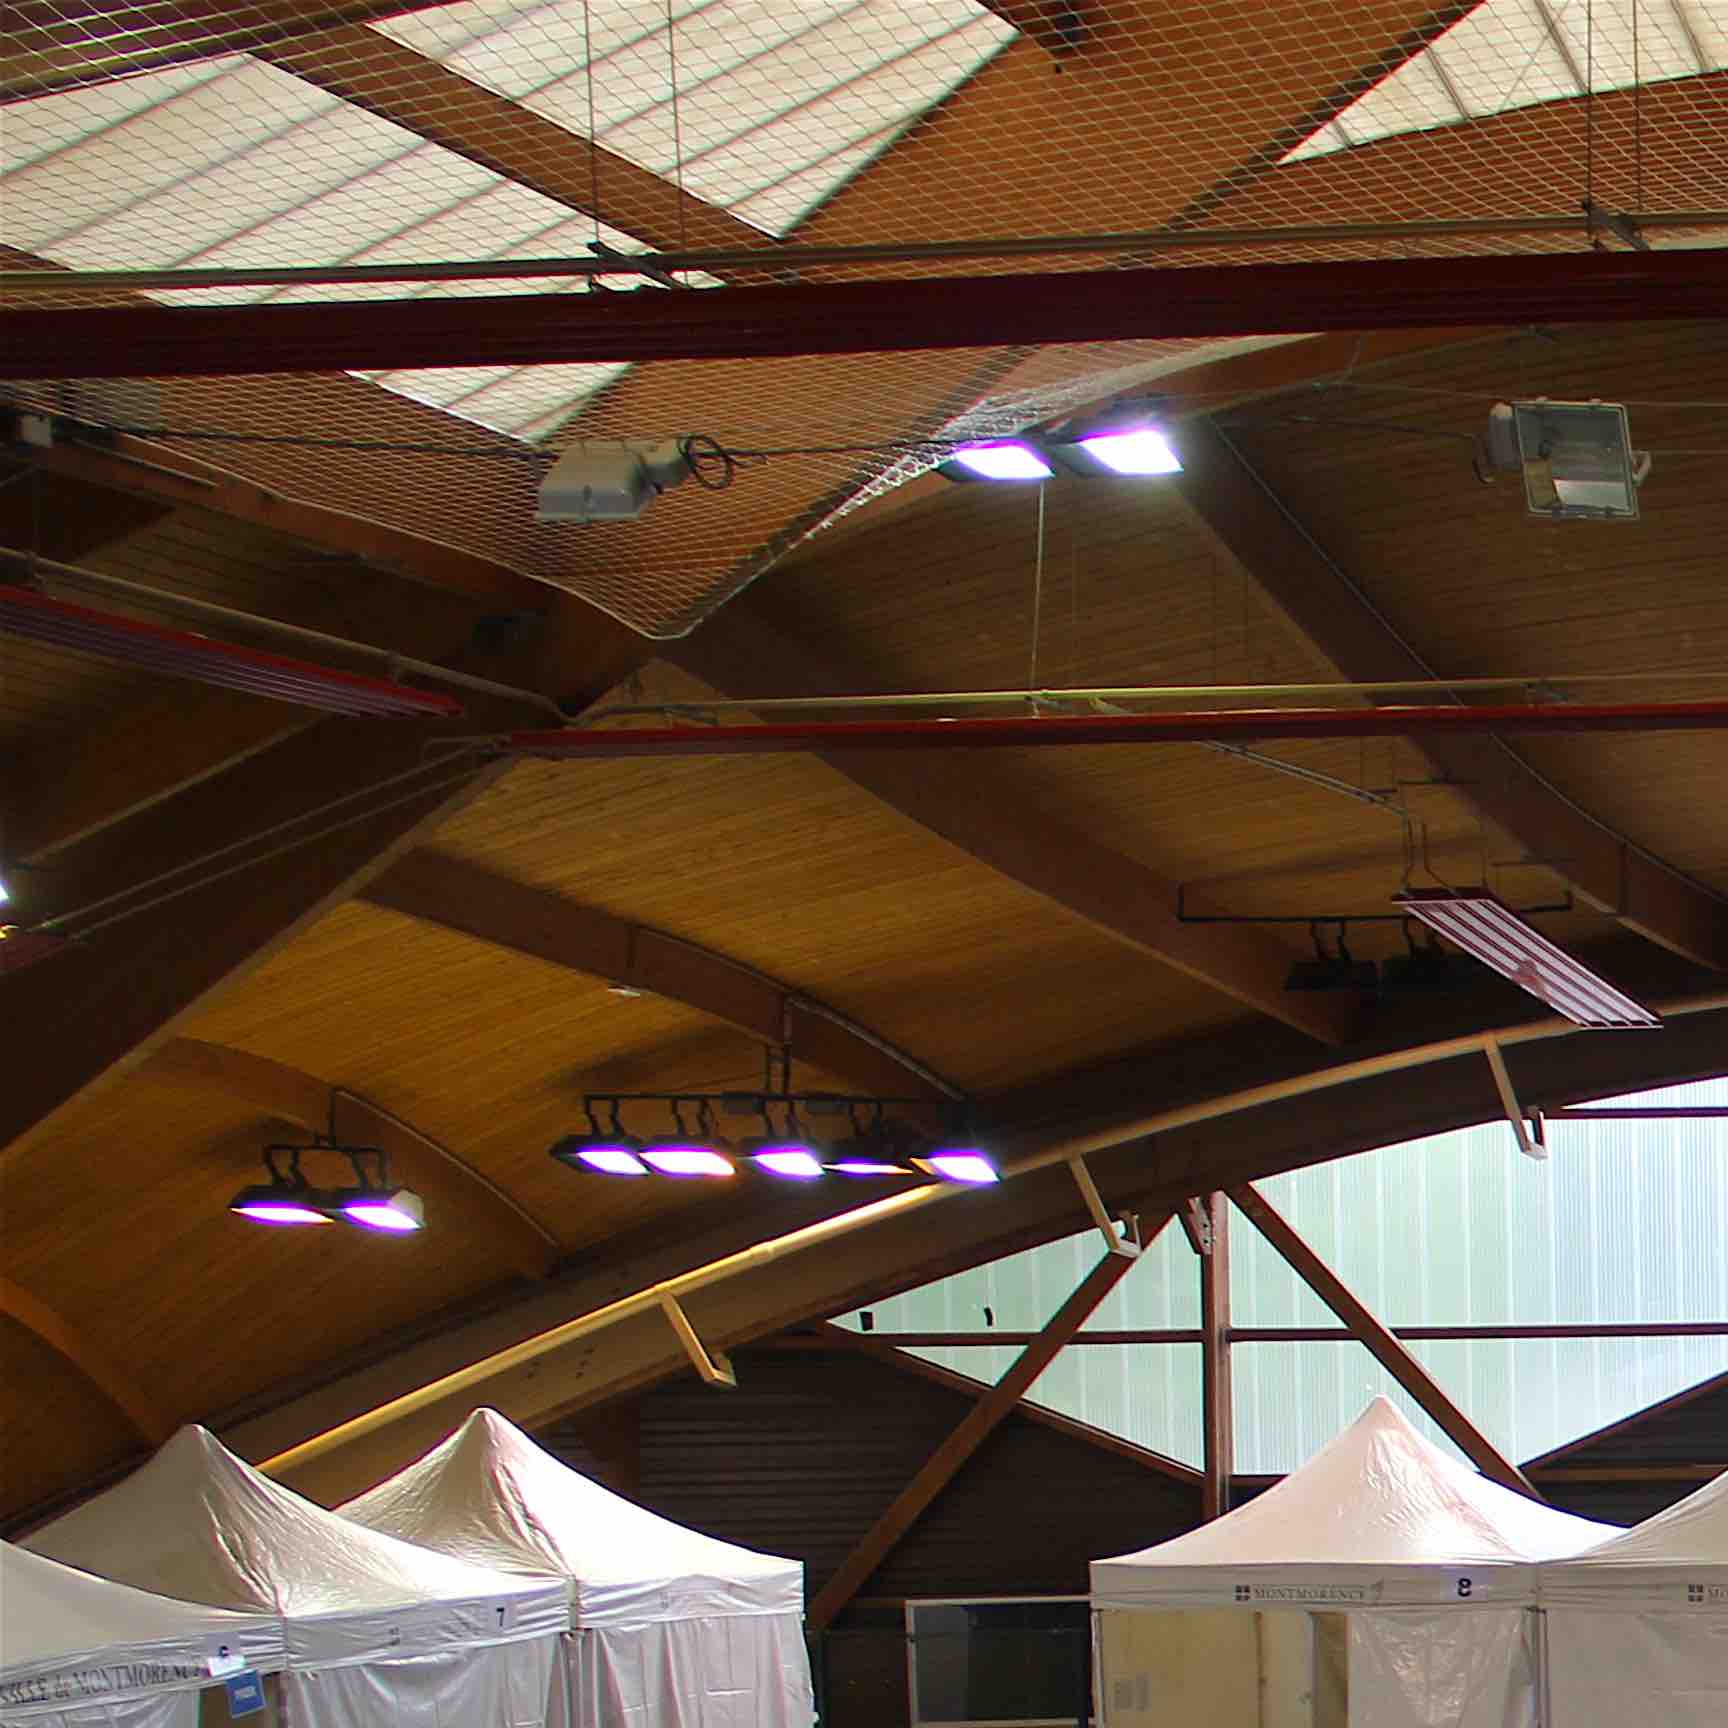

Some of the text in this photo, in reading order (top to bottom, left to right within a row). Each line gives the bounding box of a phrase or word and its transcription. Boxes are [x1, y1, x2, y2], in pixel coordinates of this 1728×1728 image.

[1254, 1586, 1366, 1601] MONTMORENCY
[1457, 1578, 1473, 1597] 8
[495, 1607, 506, 1628] 7
